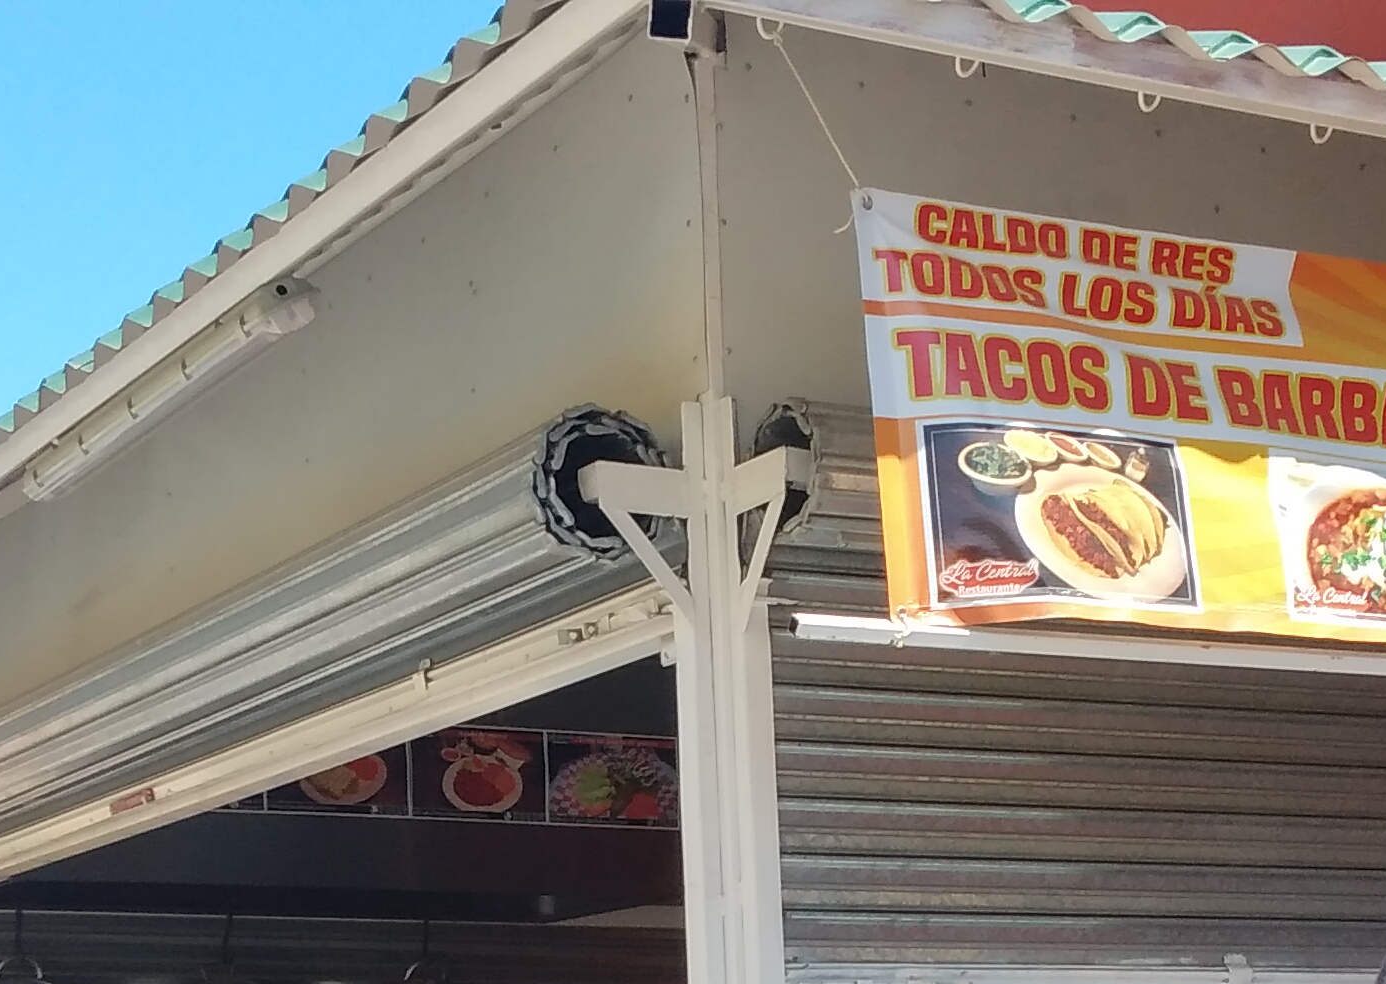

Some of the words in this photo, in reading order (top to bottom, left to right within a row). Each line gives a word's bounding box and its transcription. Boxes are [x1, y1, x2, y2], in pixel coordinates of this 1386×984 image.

[915, 202, 1068, 259] CALDO
[1081, 230, 1140, 272] DE
[1150, 238, 1236, 285] RES
[873, 248, 1046, 310] TODOS
[1060, 272, 1156, 327] LOS
[1169, 278, 1286, 340] DÍAS
[896, 329, 1114, 414] TACOS
[1125, 351, 1213, 425] DE
[975, 560, 1039, 582] Central
